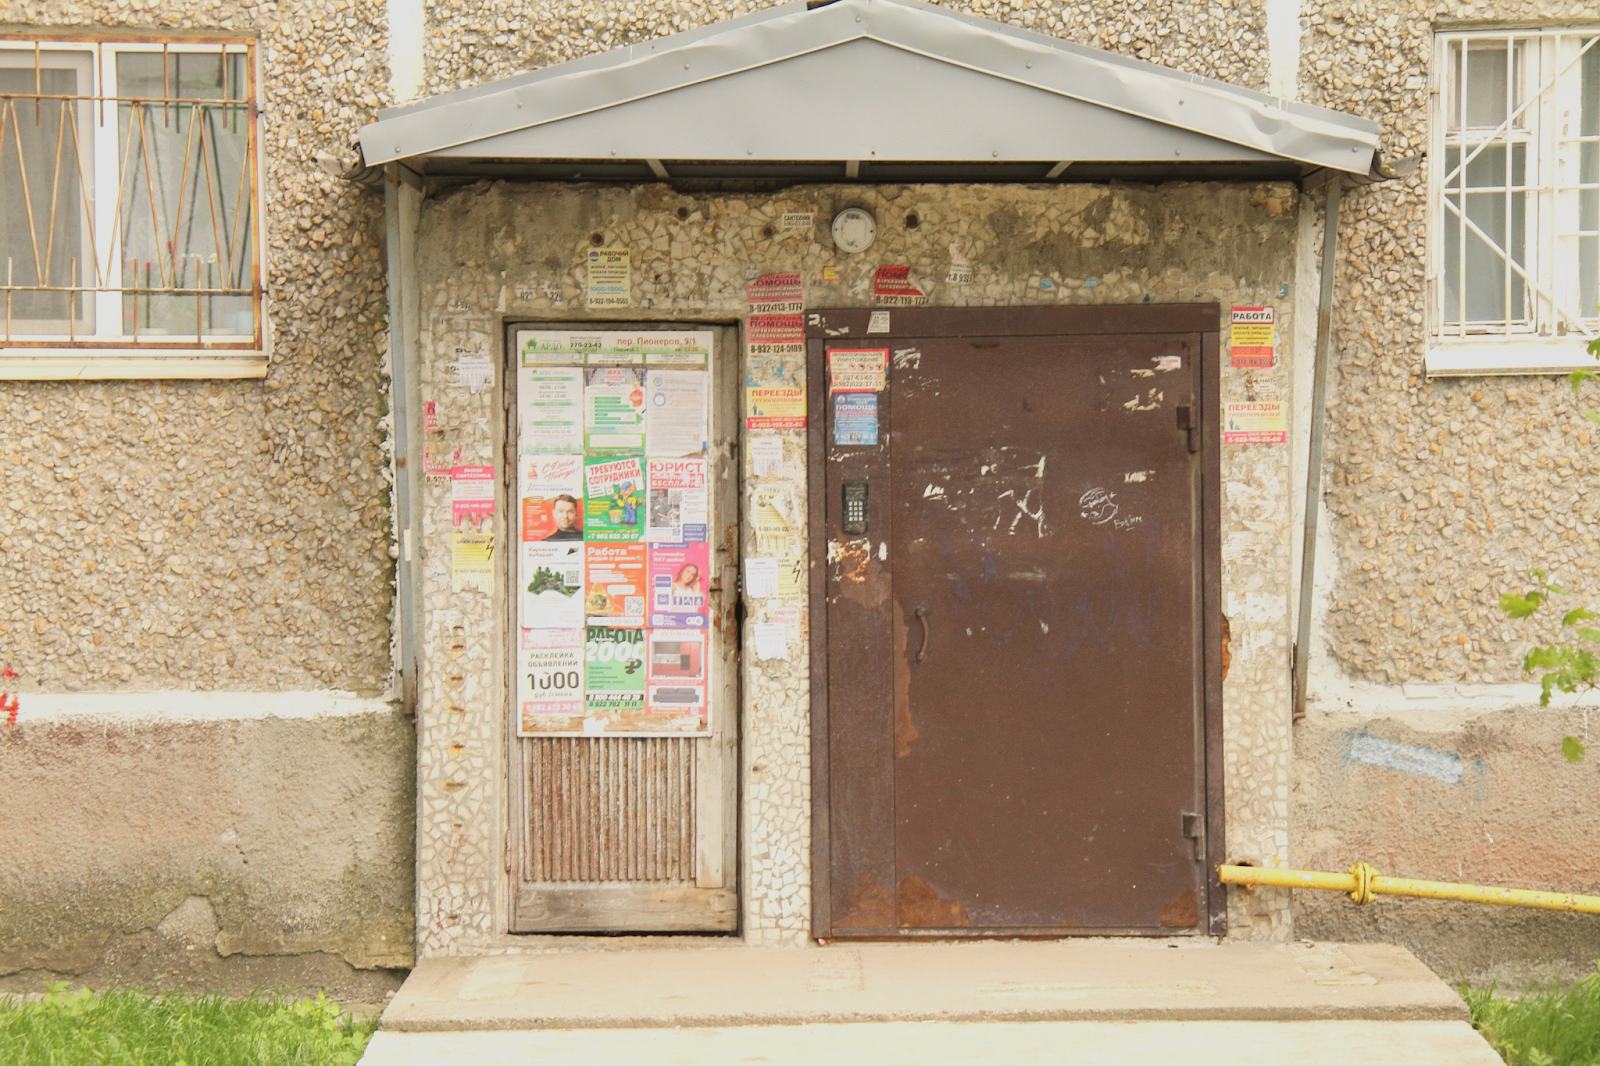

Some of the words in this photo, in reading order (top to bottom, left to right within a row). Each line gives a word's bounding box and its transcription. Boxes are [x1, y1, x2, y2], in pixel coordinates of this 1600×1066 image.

[599, 249, 629, 257] РАБОЧИЙ
[1233, 312, 1272, 320] РАБОТА
[750, 320, 803, 328] ПОМОЩЬ
[540, 343, 562, 351] АРДО
[617, 338, 634, 347] пер.
[684, 337, 697, 346] 9/1
[752, 389, 803, 397] ПЕРЕЕЗДЫ
[1228, 403, 1280, 412] ПЕРЕЕЗДЫ
[590, 459, 637, 476] ТРЕБУЮТСЯ
[650, 461, 703, 473] ЮРИСТ
[588, 468, 641, 485] СОТРУДНИКИ
[588, 546, 628, 556] Работа
[586, 628, 644, 645] РАБОТА
[530, 651, 575, 660] РАСКЛЕЙКА
[527, 660, 579, 668] ОБЪЯВЛЕНИЙ
[527, 671, 580, 691] 1000
